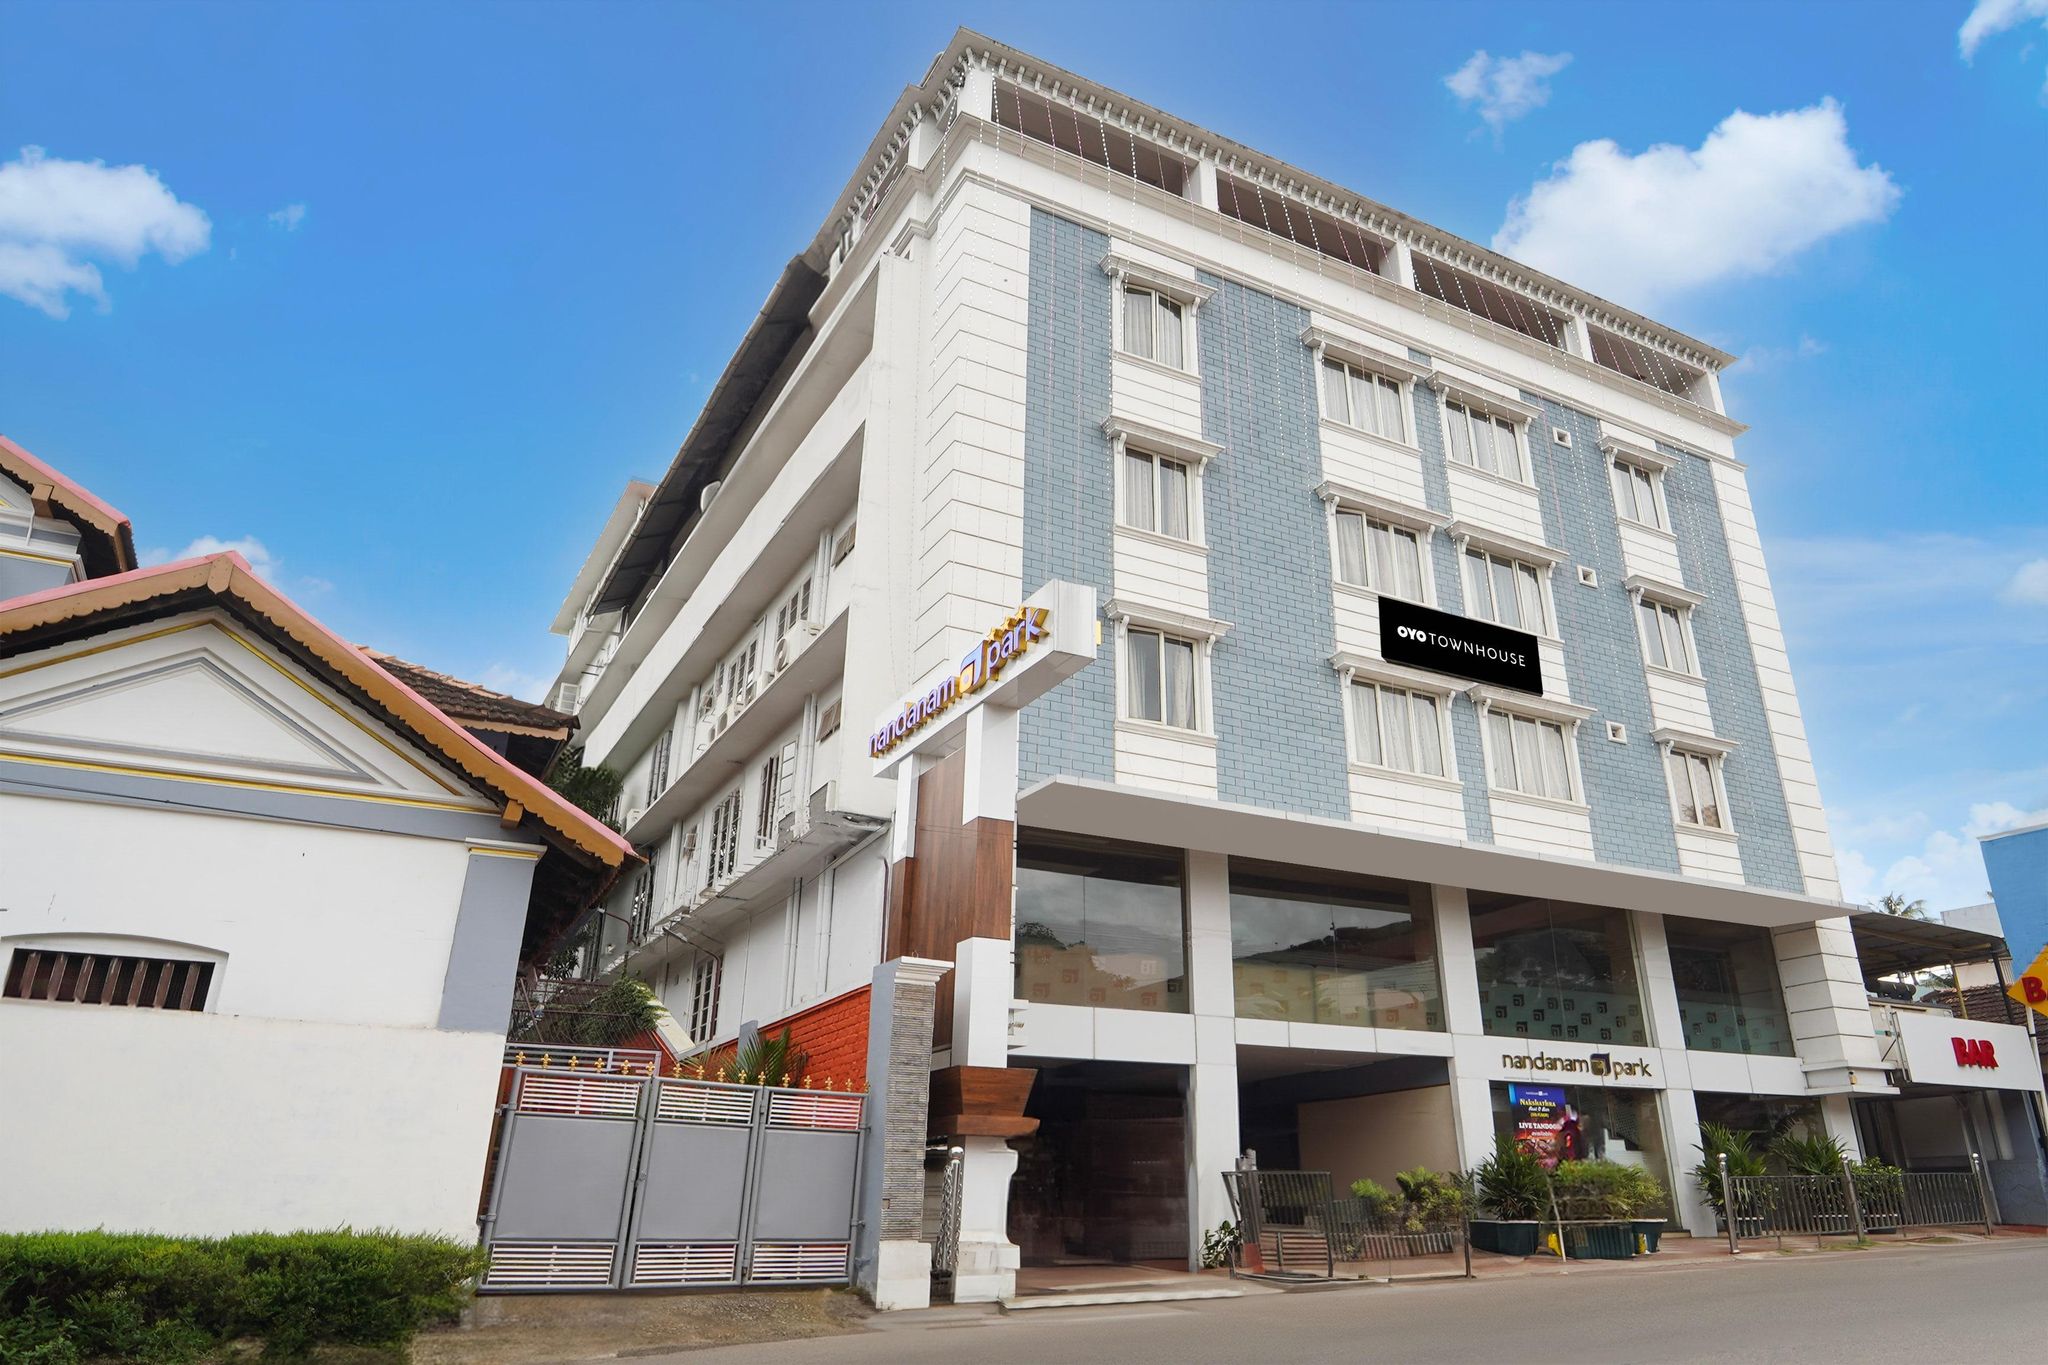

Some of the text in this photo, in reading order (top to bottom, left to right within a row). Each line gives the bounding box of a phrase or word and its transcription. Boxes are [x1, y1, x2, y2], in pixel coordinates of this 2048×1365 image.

[1397, 625, 1526, 667] OYO TOWNHOUSE
[868, 606, 1050, 759] nandanam park
[2021, 975, 2048, 1005] B
[1502, 1051, 1652, 1080] nandanam park
[1950, 1036, 1999, 1070] BAR
